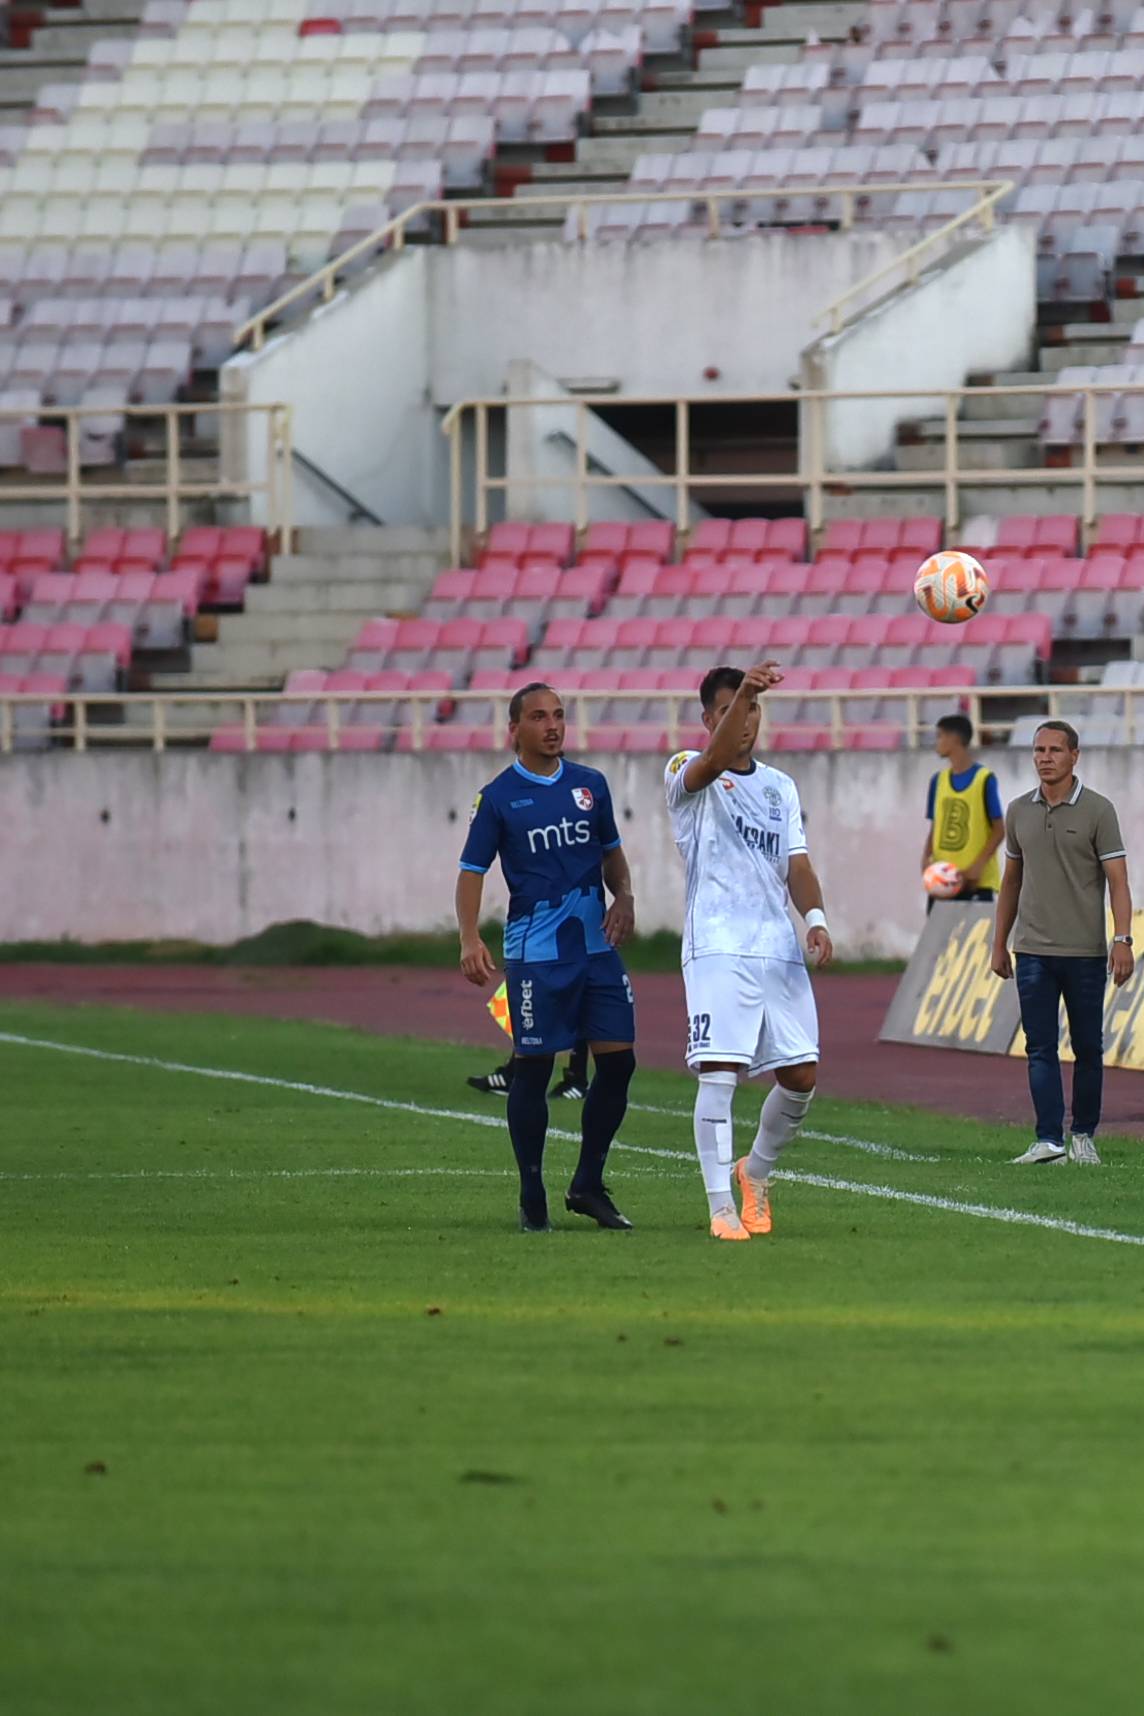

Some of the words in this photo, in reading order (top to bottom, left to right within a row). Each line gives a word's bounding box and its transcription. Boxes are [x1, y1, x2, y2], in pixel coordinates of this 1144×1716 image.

[527, 816, 591, 854] mts
[939, 797, 971, 852] B
[520, 979, 535, 1031] efbet
[692, 1013, 711, 1042] 32
